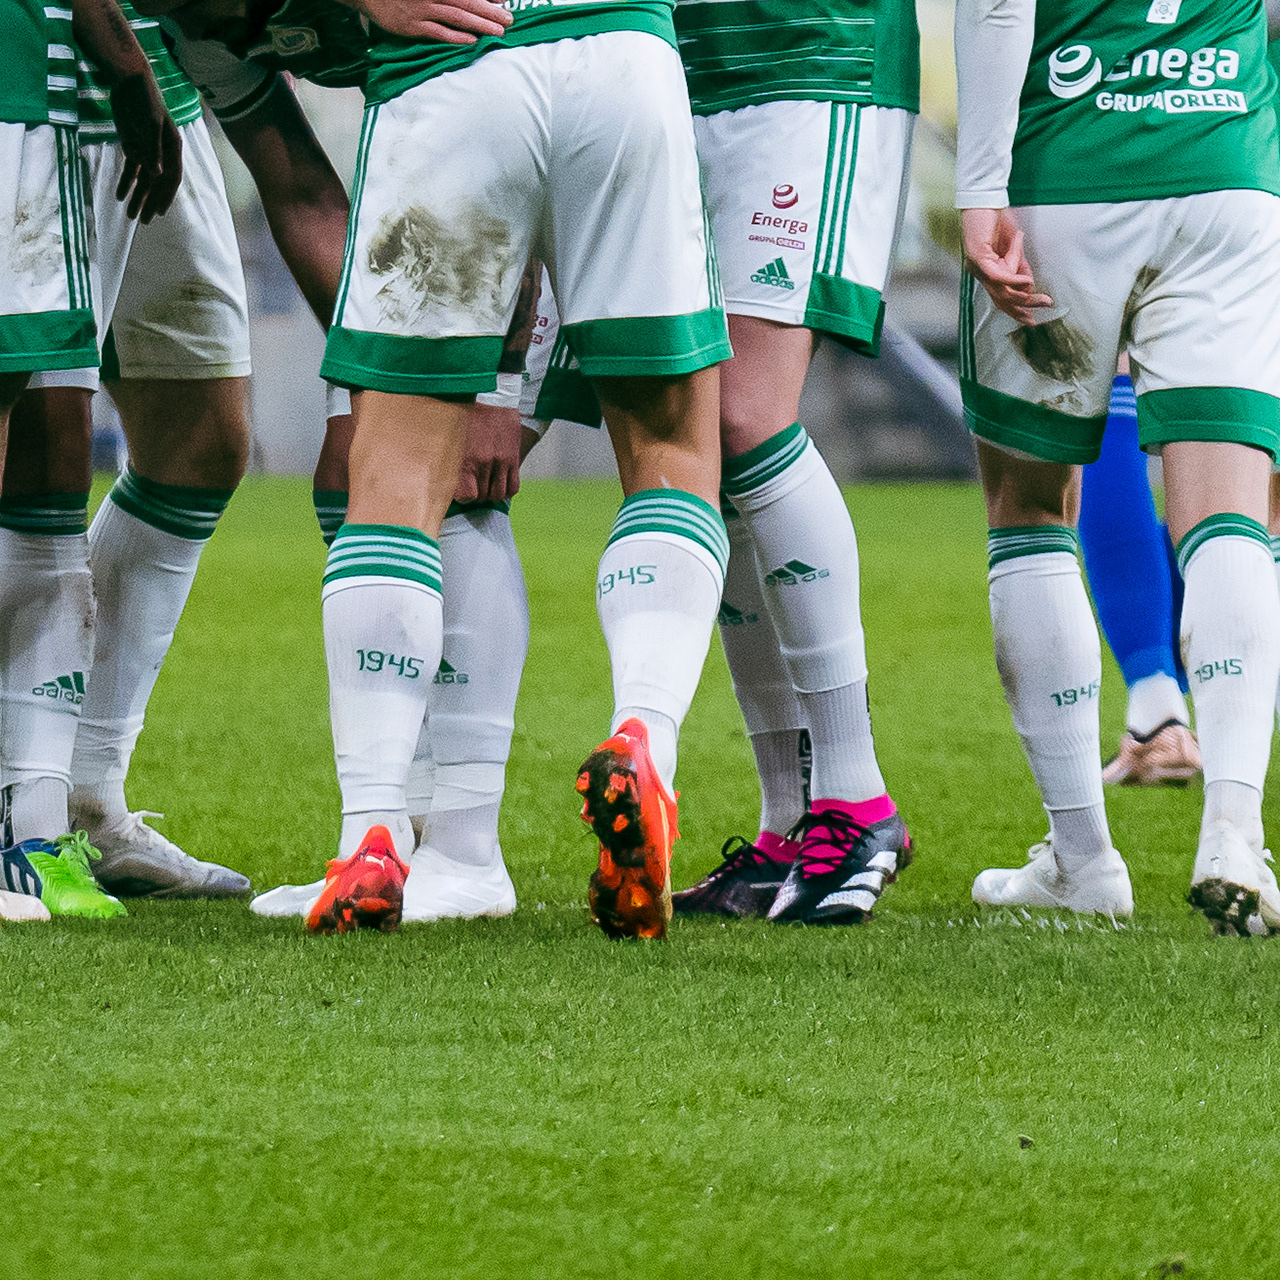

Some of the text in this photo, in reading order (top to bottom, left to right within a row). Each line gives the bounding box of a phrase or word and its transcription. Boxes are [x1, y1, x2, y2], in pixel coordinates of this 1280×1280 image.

[1095, 91, 1241, 112] GRUPA ORLEN
[751, 212, 809, 235] Energa
[750, 273, 795, 291] adidas
[597, 565, 658, 600] 1945
[356, 649, 425, 680] 1945
[1193, 658, 1243, 683] 1945
